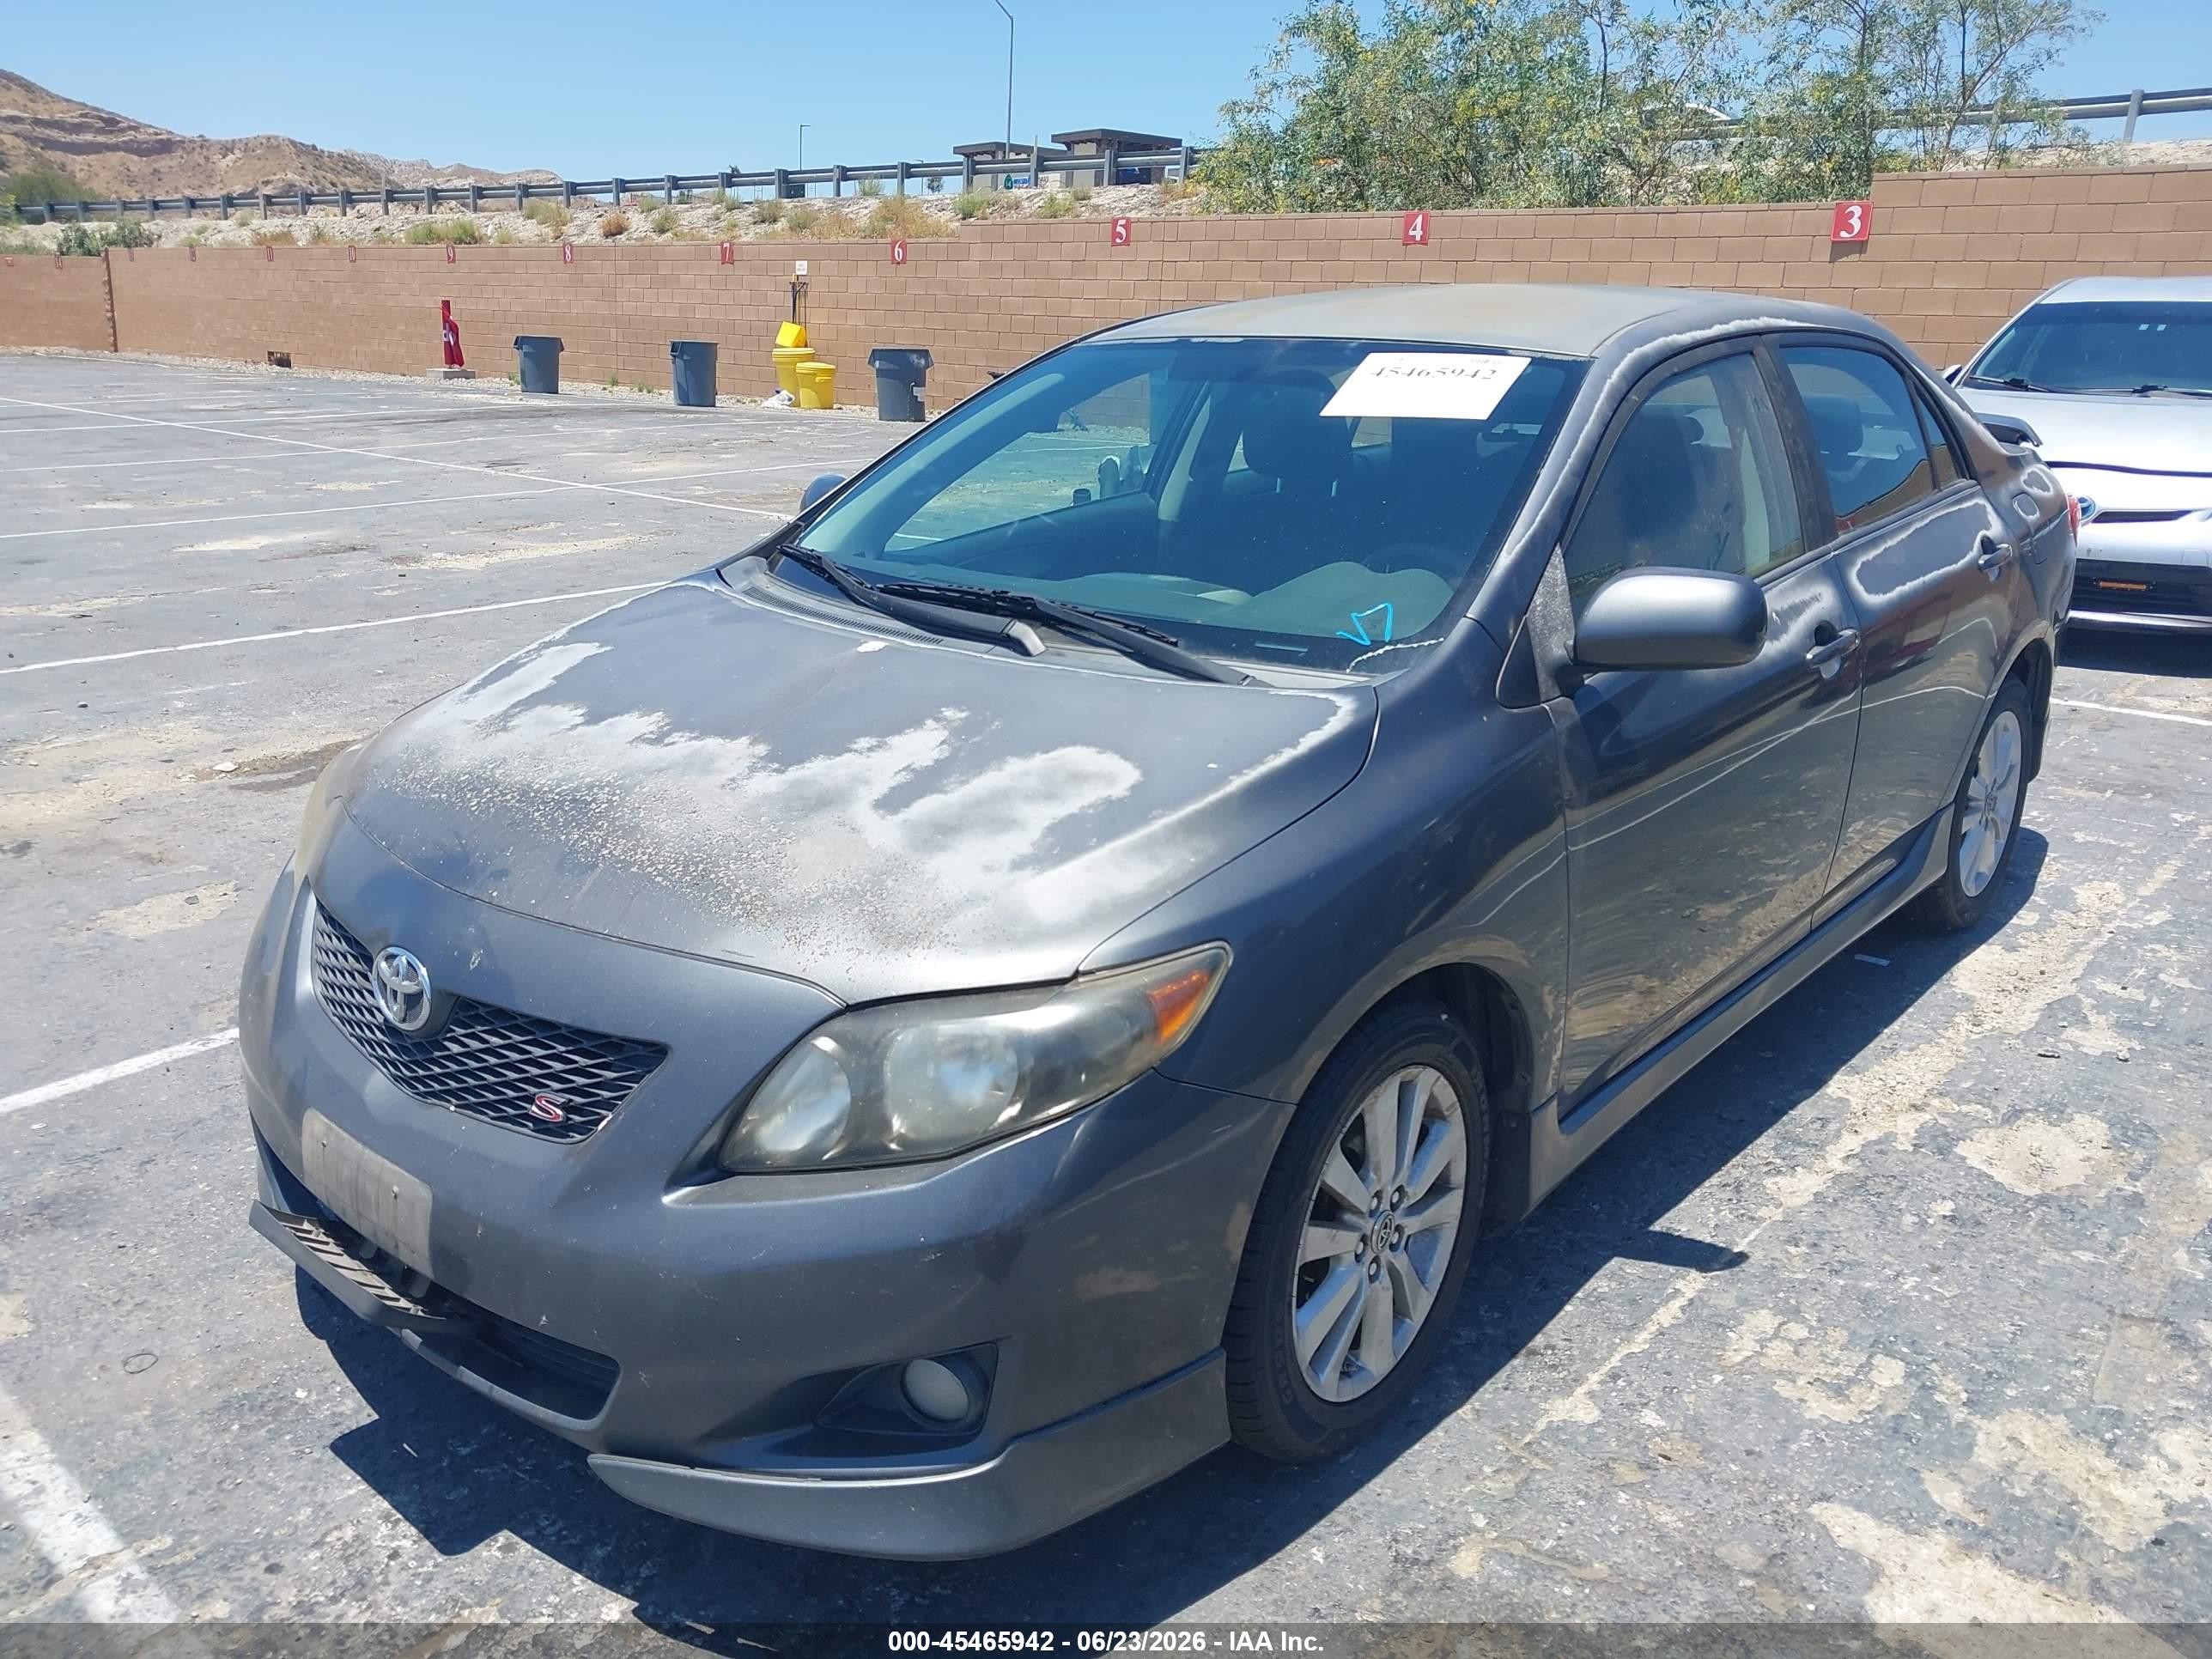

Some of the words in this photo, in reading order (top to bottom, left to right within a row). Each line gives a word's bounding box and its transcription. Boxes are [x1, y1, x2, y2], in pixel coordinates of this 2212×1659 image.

[1115, 219, 1127, 243] 5
[1408, 214, 1423, 241] 4
[1839, 205, 1863, 238] 3
[447, 246, 453, 262] 9
[565, 244, 572, 263] 8
[722, 242, 731, 262] 7
[894, 240, 903, 262] 6
[529, 1092, 566, 1121] S
